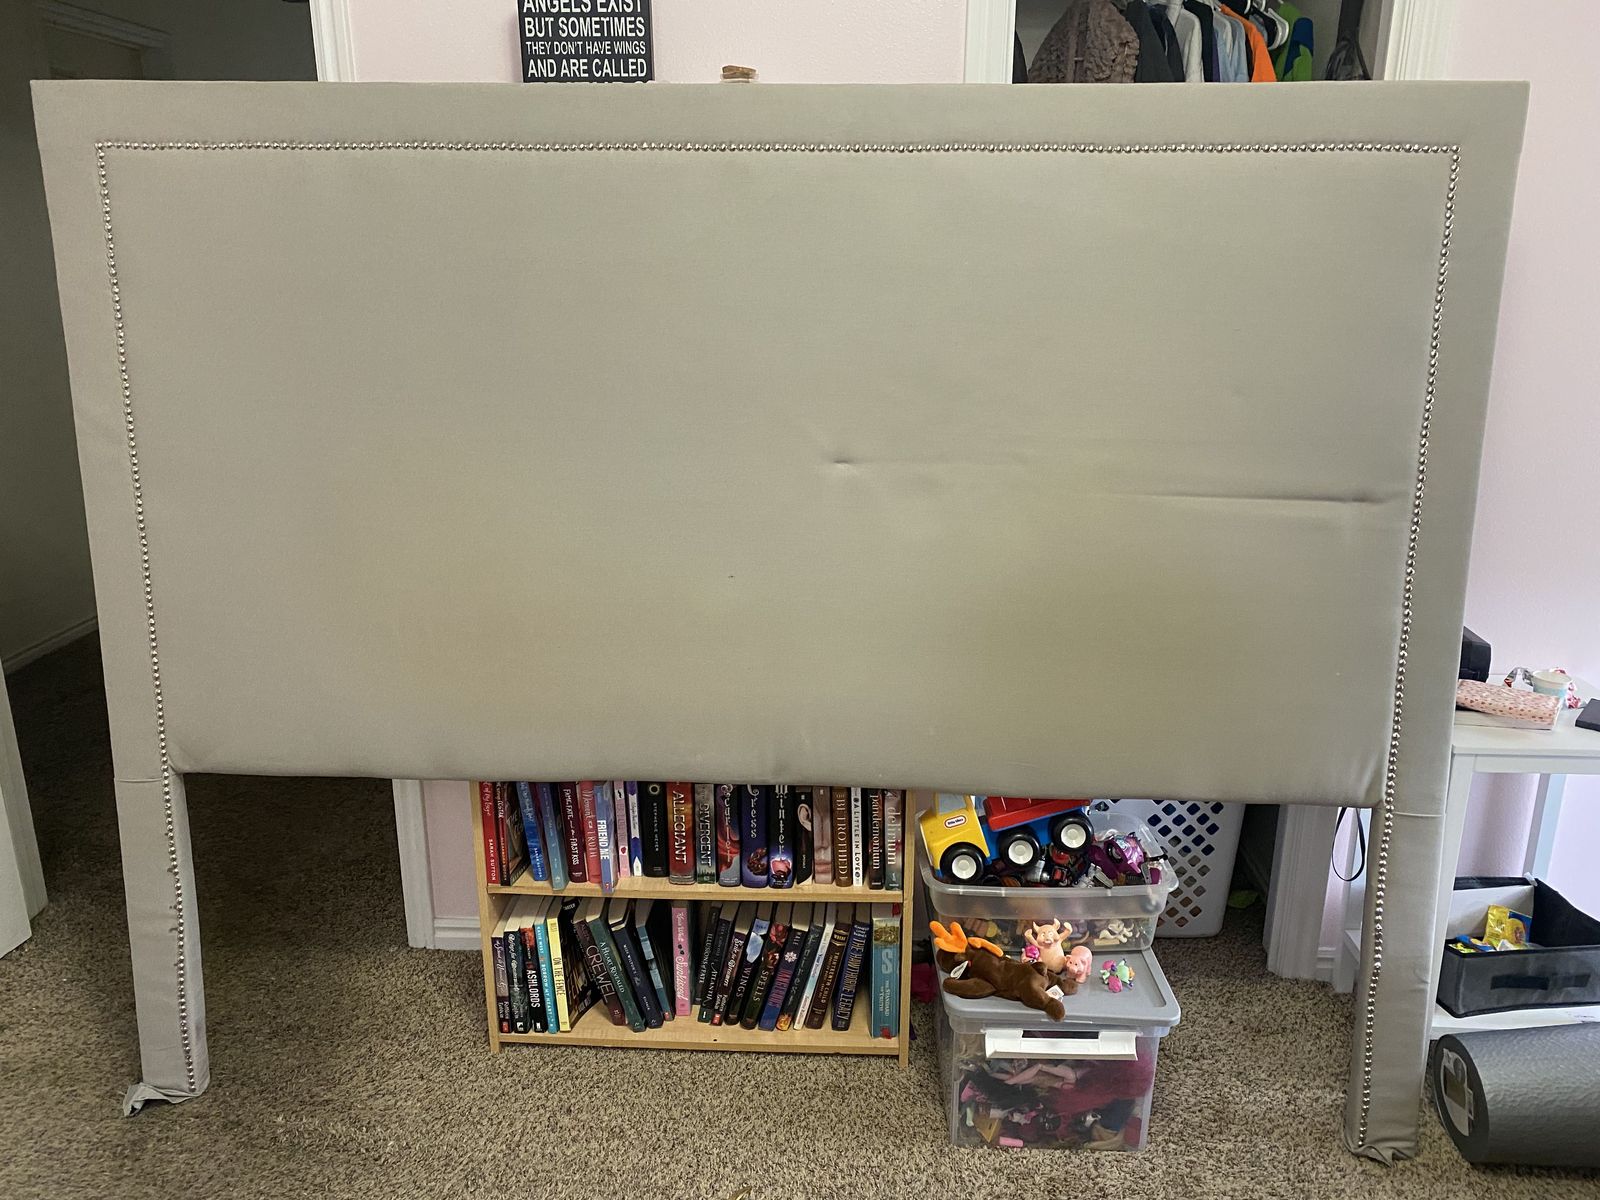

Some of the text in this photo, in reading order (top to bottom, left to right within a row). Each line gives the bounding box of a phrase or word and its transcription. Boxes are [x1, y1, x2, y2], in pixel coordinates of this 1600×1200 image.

[523, 0, 642, 13] ANGELS EXIST
[525, 17, 645, 38] BUT SOMETIMES
[526, 41, 646, 55] THEY DON'T HAVE WINGS
[528, 59, 647, 78] AND ARE CALLED
[582, 789, 596, 819] Moment
[721, 784, 734, 862] Scarlet
[570, 838, 578, 854] FIRST
[597, 819, 610, 860] FRIEND ME
[672, 790, 687, 864] ALLEGIANT
[699, 803, 712, 867] DIVERGENT
[836, 799, 848, 874] BETROTHED
[855, 840, 861, 849] IN
[870, 794, 882, 869] pandemonium
[887, 806, 901, 865] delirium
[703, 933, 714, 965] ILLUSIONS
[526, 969, 541, 1008] ASHLORDS
[553, 957, 566, 996] ON THE FENCE
[586, 945, 615, 1004] CREWEL
[601, 947, 613, 966] HEART
[611, 966, 625, 993] REVEALED
[675, 956, 689, 1001] Sunkissed
[698, 969, 706, 984] FATE
[736, 966, 752, 998] WINGS
[753, 970, 769, 1002] SPELLS
[769, 968, 794, 1008] DANGEROUS
[837, 938, 866, 1020] THE HAWTHORNE LEGACY
[821, 987, 830, 1004] CHILD
